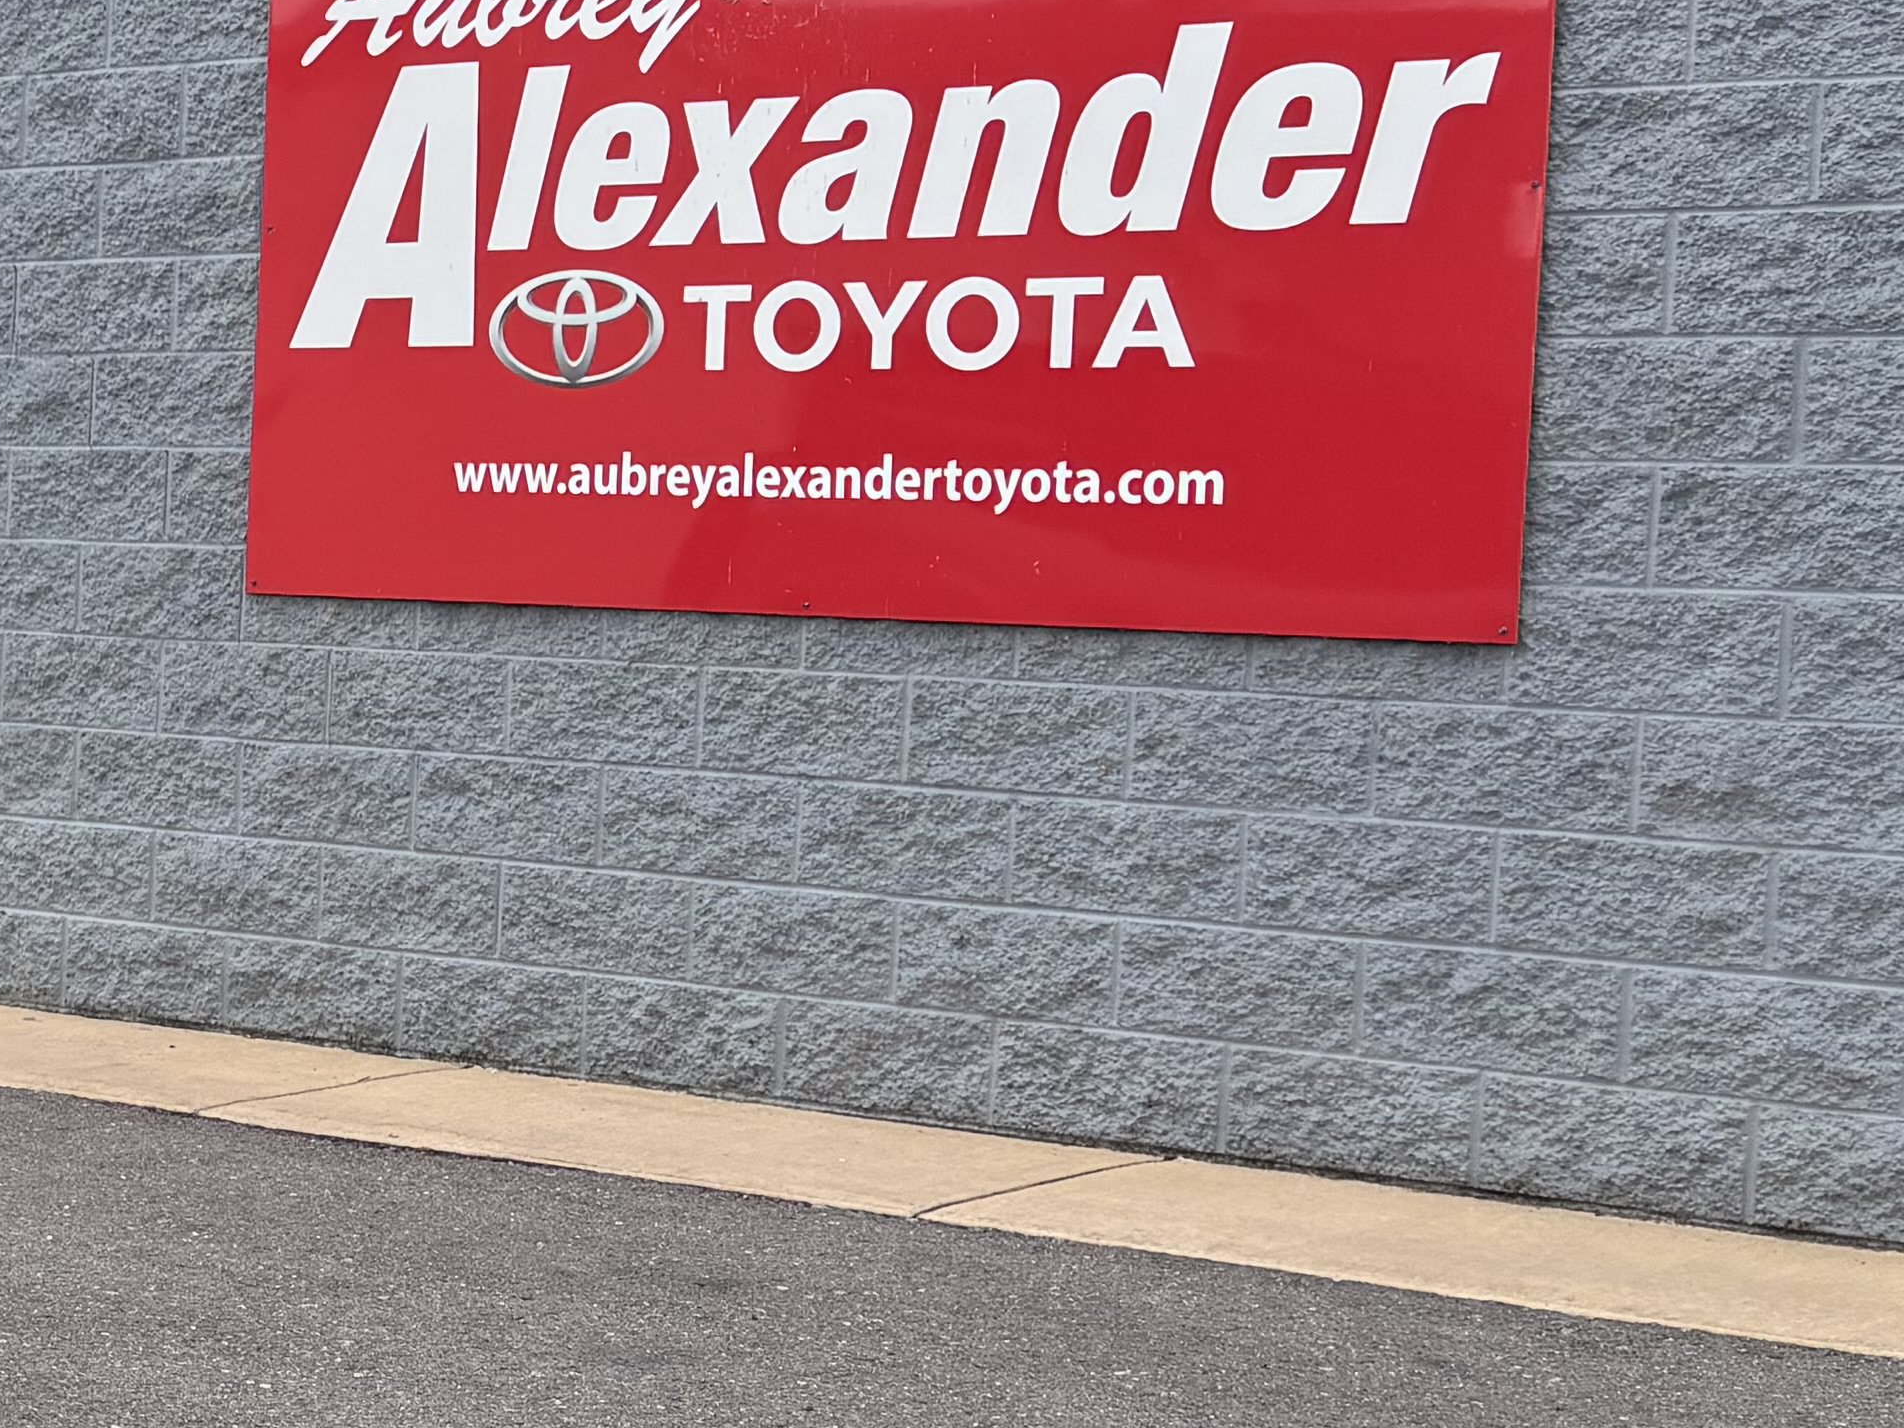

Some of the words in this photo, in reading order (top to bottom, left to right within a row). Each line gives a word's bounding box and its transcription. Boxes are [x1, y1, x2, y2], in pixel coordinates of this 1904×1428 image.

[289, 21, 1503, 350] Alexander
[682, 274, 1196, 373] TOYOTA
[453, 451, 1225, 515] www.aubreyalexandertoyota.com
